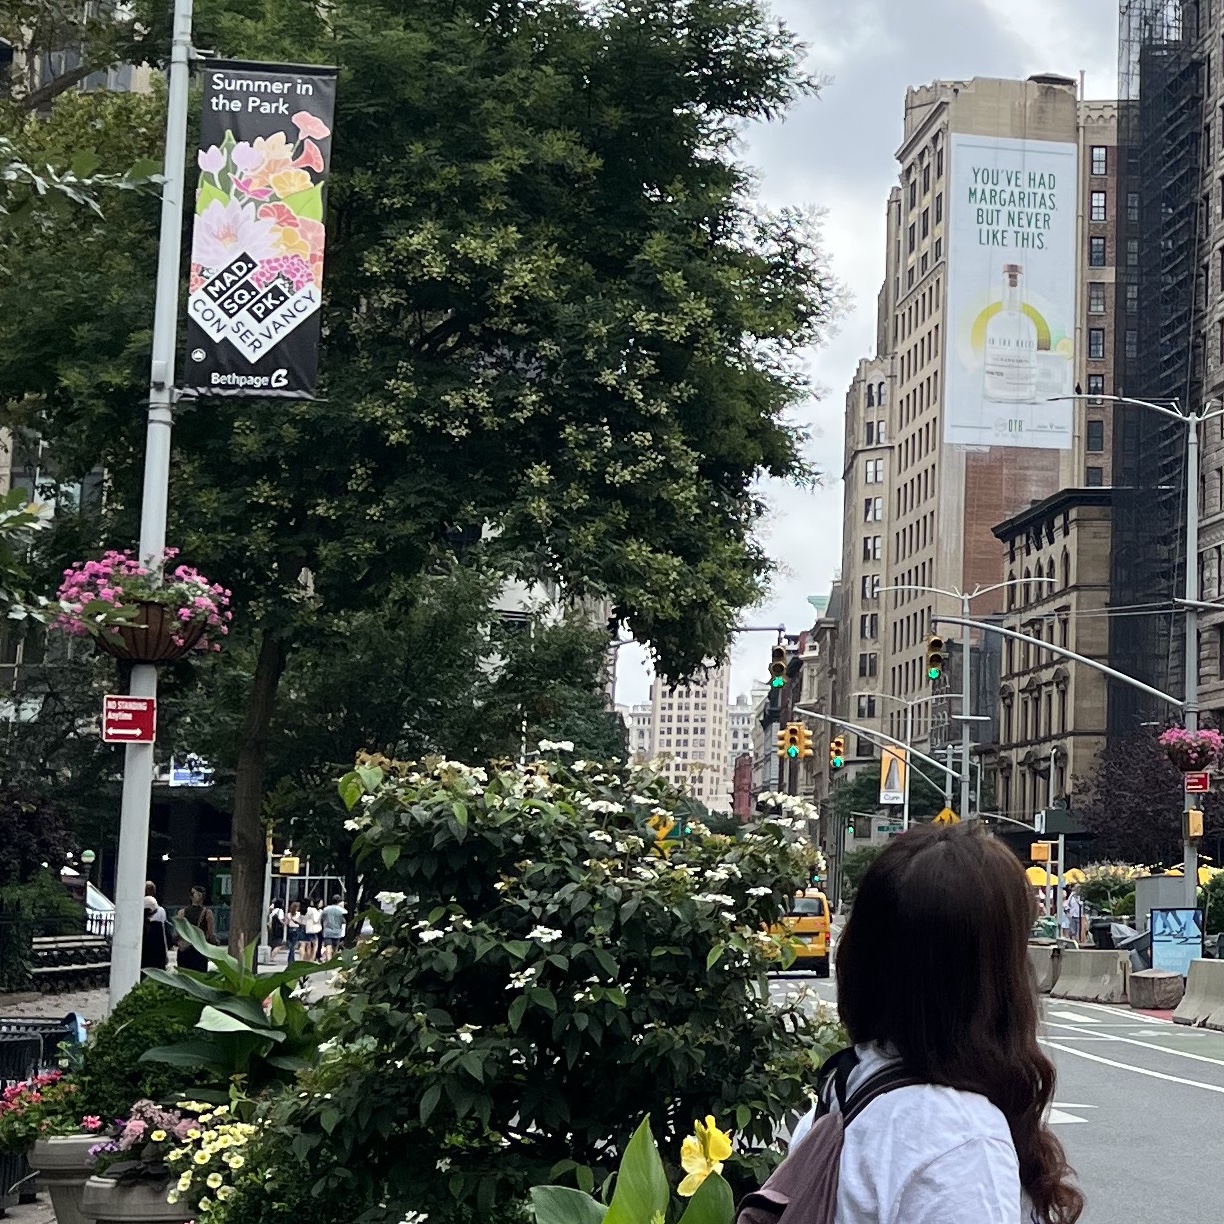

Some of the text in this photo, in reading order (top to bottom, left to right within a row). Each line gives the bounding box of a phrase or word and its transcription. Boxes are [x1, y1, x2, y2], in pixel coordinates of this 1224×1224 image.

[211, 73, 313, 96] Summer in
[210, 94, 289, 115] the Park
[972, 166, 1056, 190] YOU'VE HAD
[968, 187, 1058, 211] MARGARITAS.
[976, 208, 1051, 230] BUT NEVER
[979, 228, 1008, 247] LIKE
[206, 260, 253, 298] MAD.
[223, 288, 257, 314] SQ.
[251, 292, 285, 319] PK.
[210, 372, 270, 387] Bethpage
